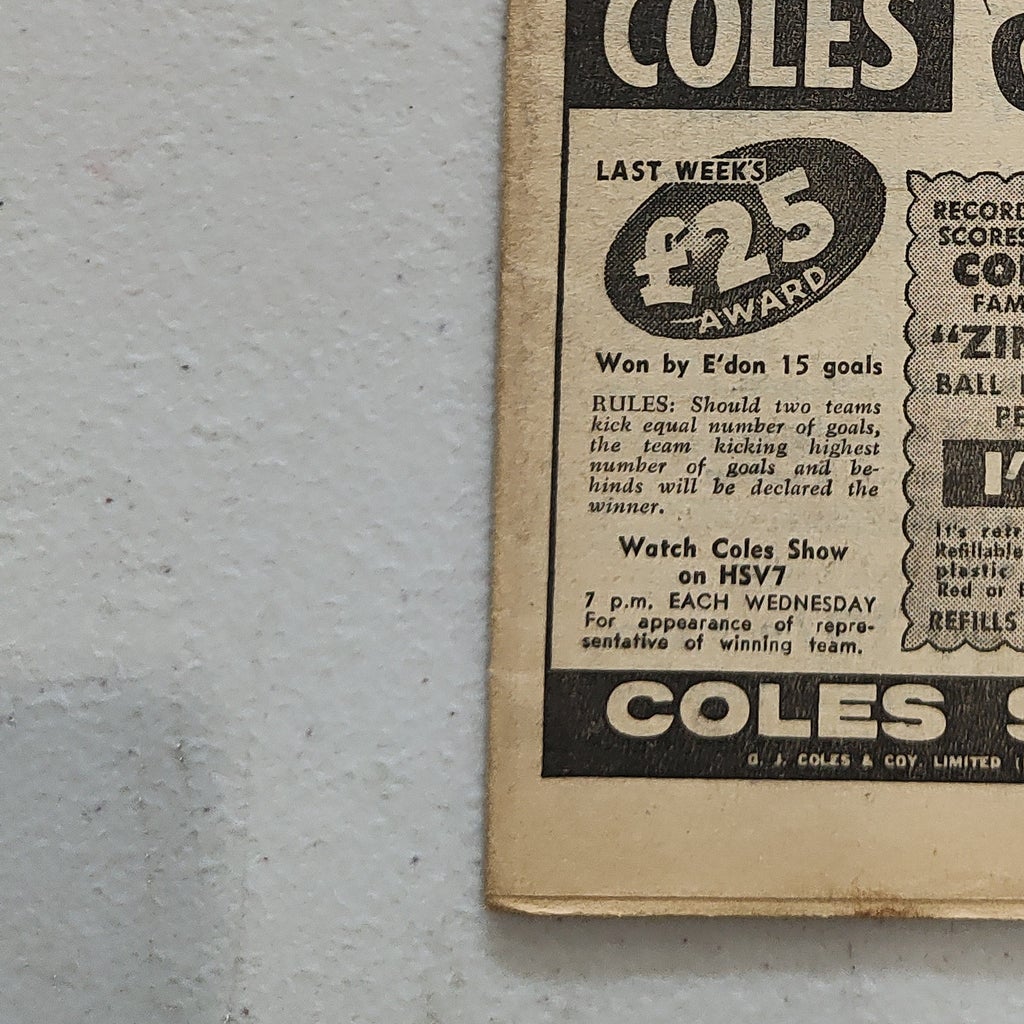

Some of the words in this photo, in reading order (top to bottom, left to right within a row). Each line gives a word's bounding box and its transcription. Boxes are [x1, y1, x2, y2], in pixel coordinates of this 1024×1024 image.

[597, 160, 662, 182] LAST
[675, 159, 766, 183] WEEK'S
[634, 166, 835, 307] £25
[699, 266, 828, 334] AWARD
[596, 352, 649, 374] Won
[663, 353, 690, 378] by
[703, 353, 766, 375] E'don
[782, 354, 809, 375] 15
[823, 355, 883, 378] goals
[936, 373, 1001, 396] BALL
[592, 394, 676, 414] RULES:
[691, 395, 761, 414] Should
[775, 400, 811, 415] two
[825, 399, 881, 415] teams
[591, 416, 632, 433] kick
[643, 417, 698, 436] equal
[709, 418, 784, 435] number
[796, 418, 816, 437] of
[826, 419, 881, 438] goals,
[590, 436, 621, 453] the
[644, 438, 691, 454] team
[714, 438, 788, 457] kicking
[809, 438, 880, 457] highest
[590, 457, 667, 474] number
[686, 457, 707, 478] of
[726, 458, 775, 478] goals
[795, 459, 831, 476] and
[851, 459, 880, 476] be-
[588, 476, 643, 494] hinds
[658, 477, 698, 495] will
[713, 478, 735, 495] be
[750, 478, 833, 497] declared
[848, 480, 879, 498] the
[588, 499, 665, 515] winner.
[935, 522, 967, 539] It's
[619, 535, 697, 558] Watch
[712, 538, 774, 560] Coles
[788, 538, 849, 561] Show
[678, 568, 707, 585] on
[719, 565, 787, 586] HSV7
[936, 561, 1009, 579] plastic
[937, 580, 972, 598] Red
[985, 584, 1005, 598] or
[584, 591, 595, 609] 7
[610, 594, 654, 613] p.m.
[669, 592, 730, 610] EACH
[745, 593, 877, 613] WEDNESDAY
[585, 611, 616, 628] For
[637, 616, 751, 633] appearance
[774, 615, 795, 632] of
[816, 620, 875, 637] repre-
[928, 609, 1017, 632] REFILLS
[582, 632, 669, 650] sentative
[684, 633, 704, 651] of
[720, 635, 792, 655] winning
[809, 636, 863, 655] team.
[604, 679, 947, 742] COLES
[797, 753, 850, 766] COLES
[862, 754, 873, 766] &
[933, 755, 1002, 769] LIMITED
